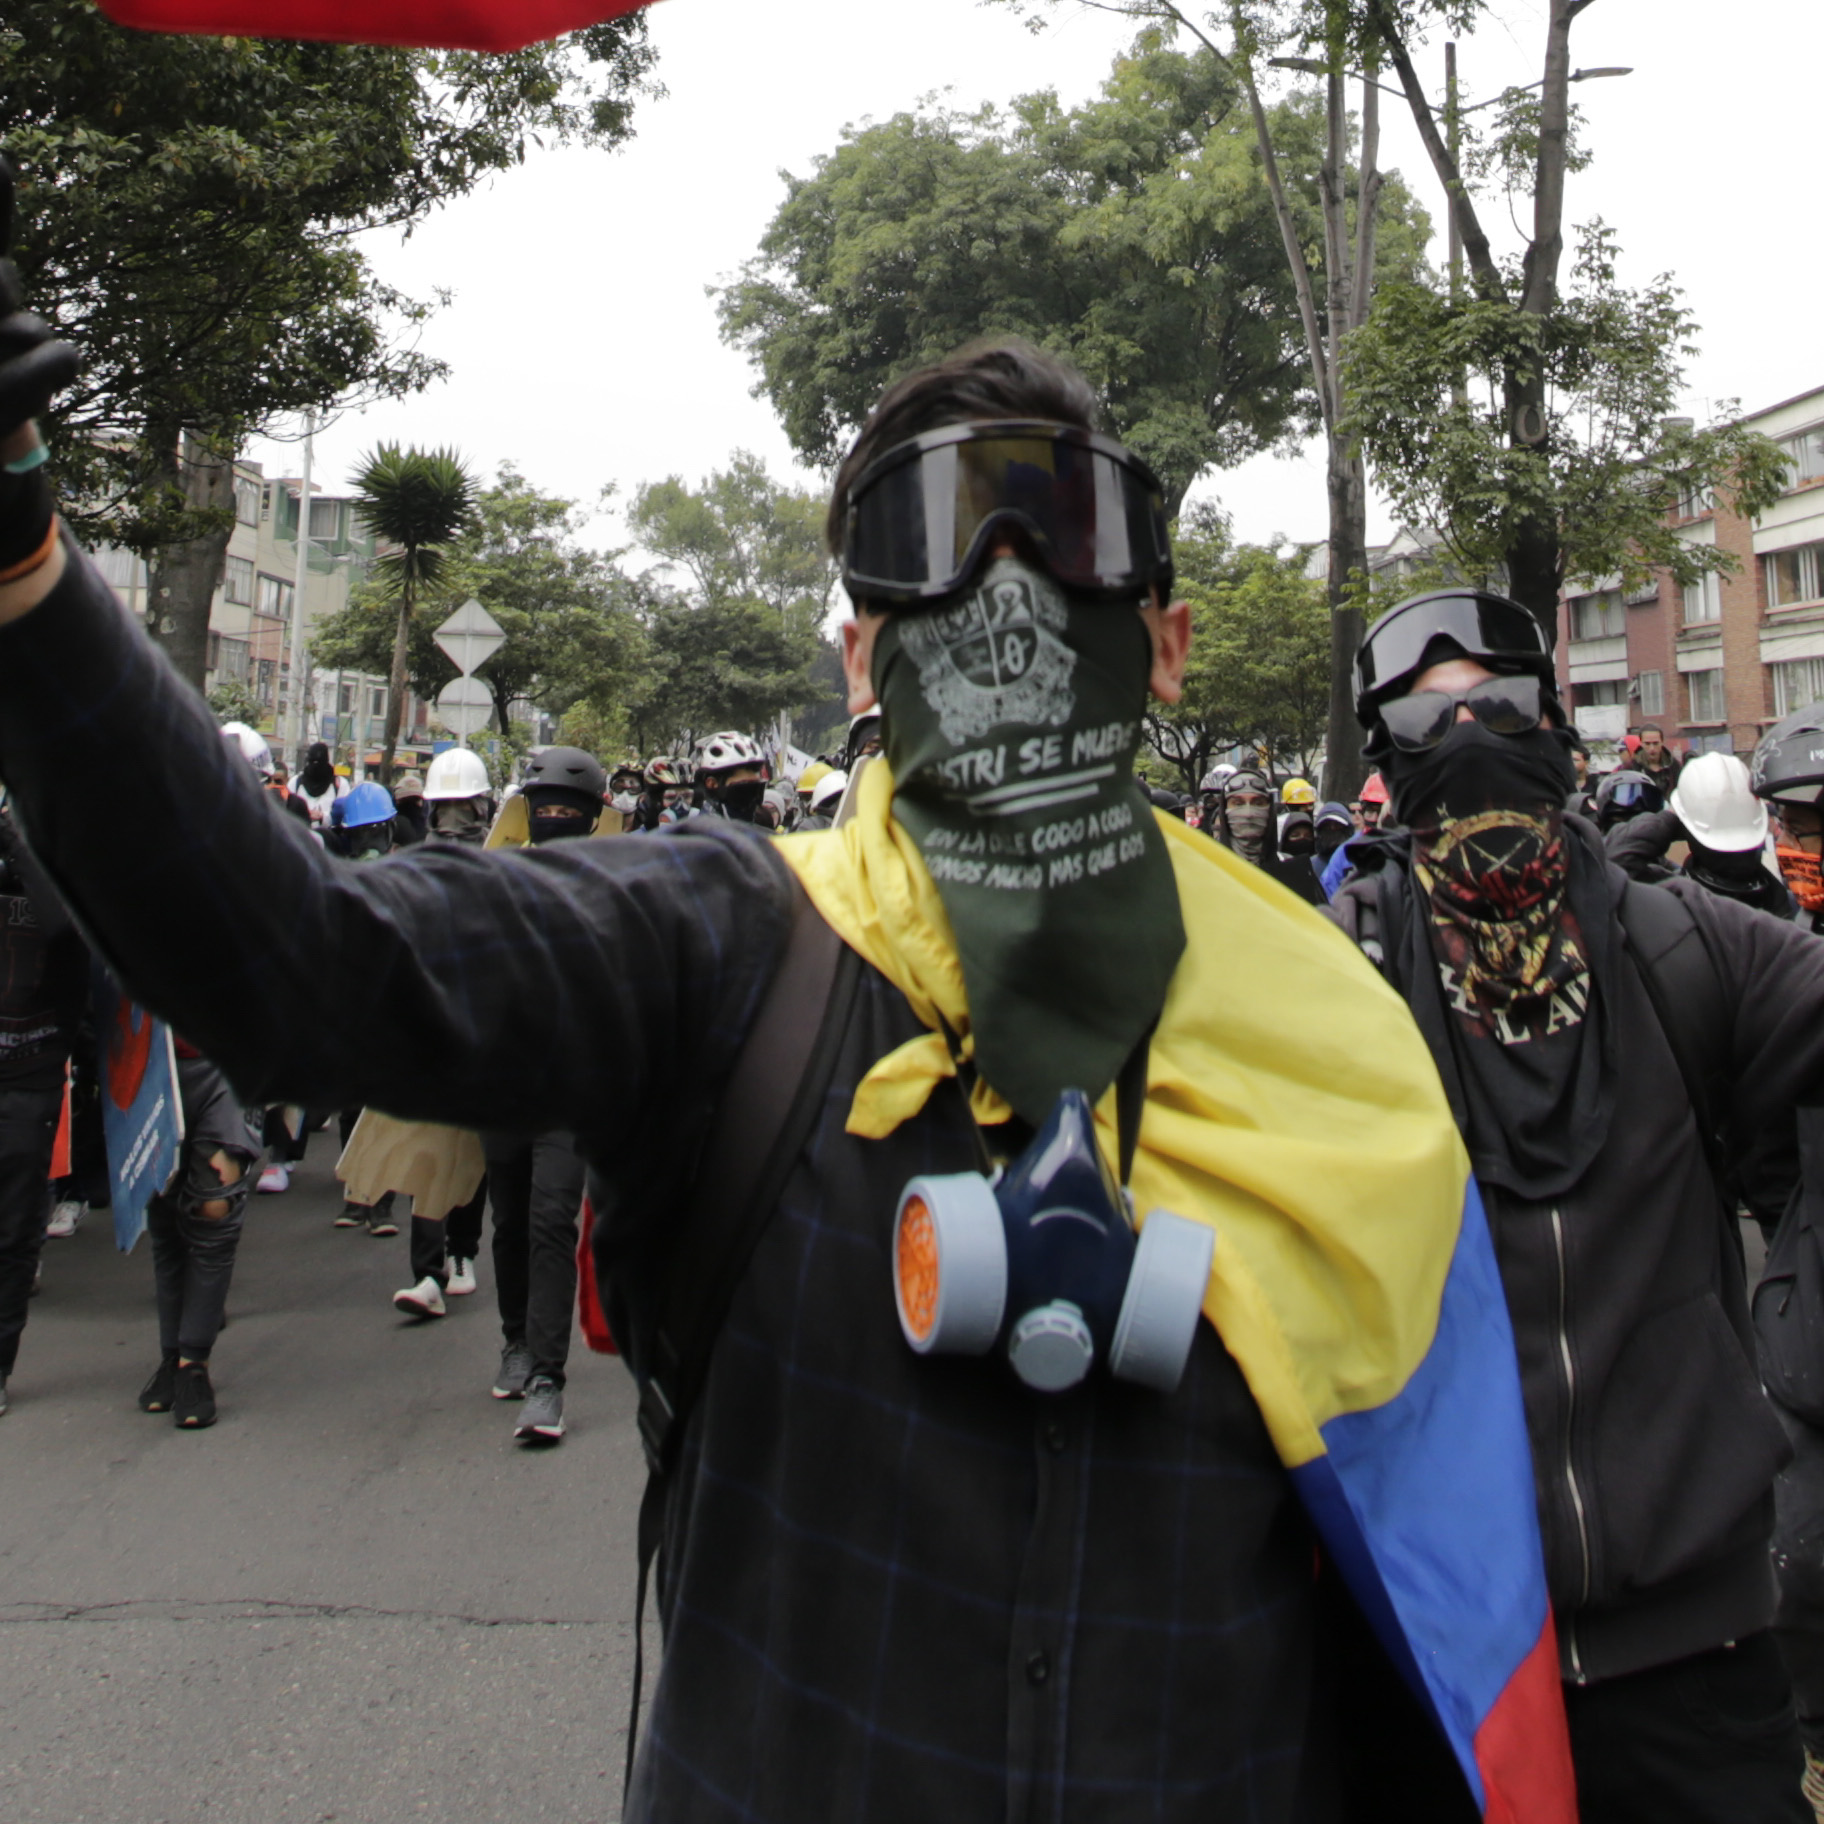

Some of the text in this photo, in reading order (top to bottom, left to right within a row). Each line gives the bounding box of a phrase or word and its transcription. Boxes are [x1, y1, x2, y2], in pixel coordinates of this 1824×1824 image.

[1018, 734, 1063, 775] SE
[1031, 817, 1084, 854] CODO
[1087, 813, 1100, 838] A
[1087, 841, 1117, 877] QUE
